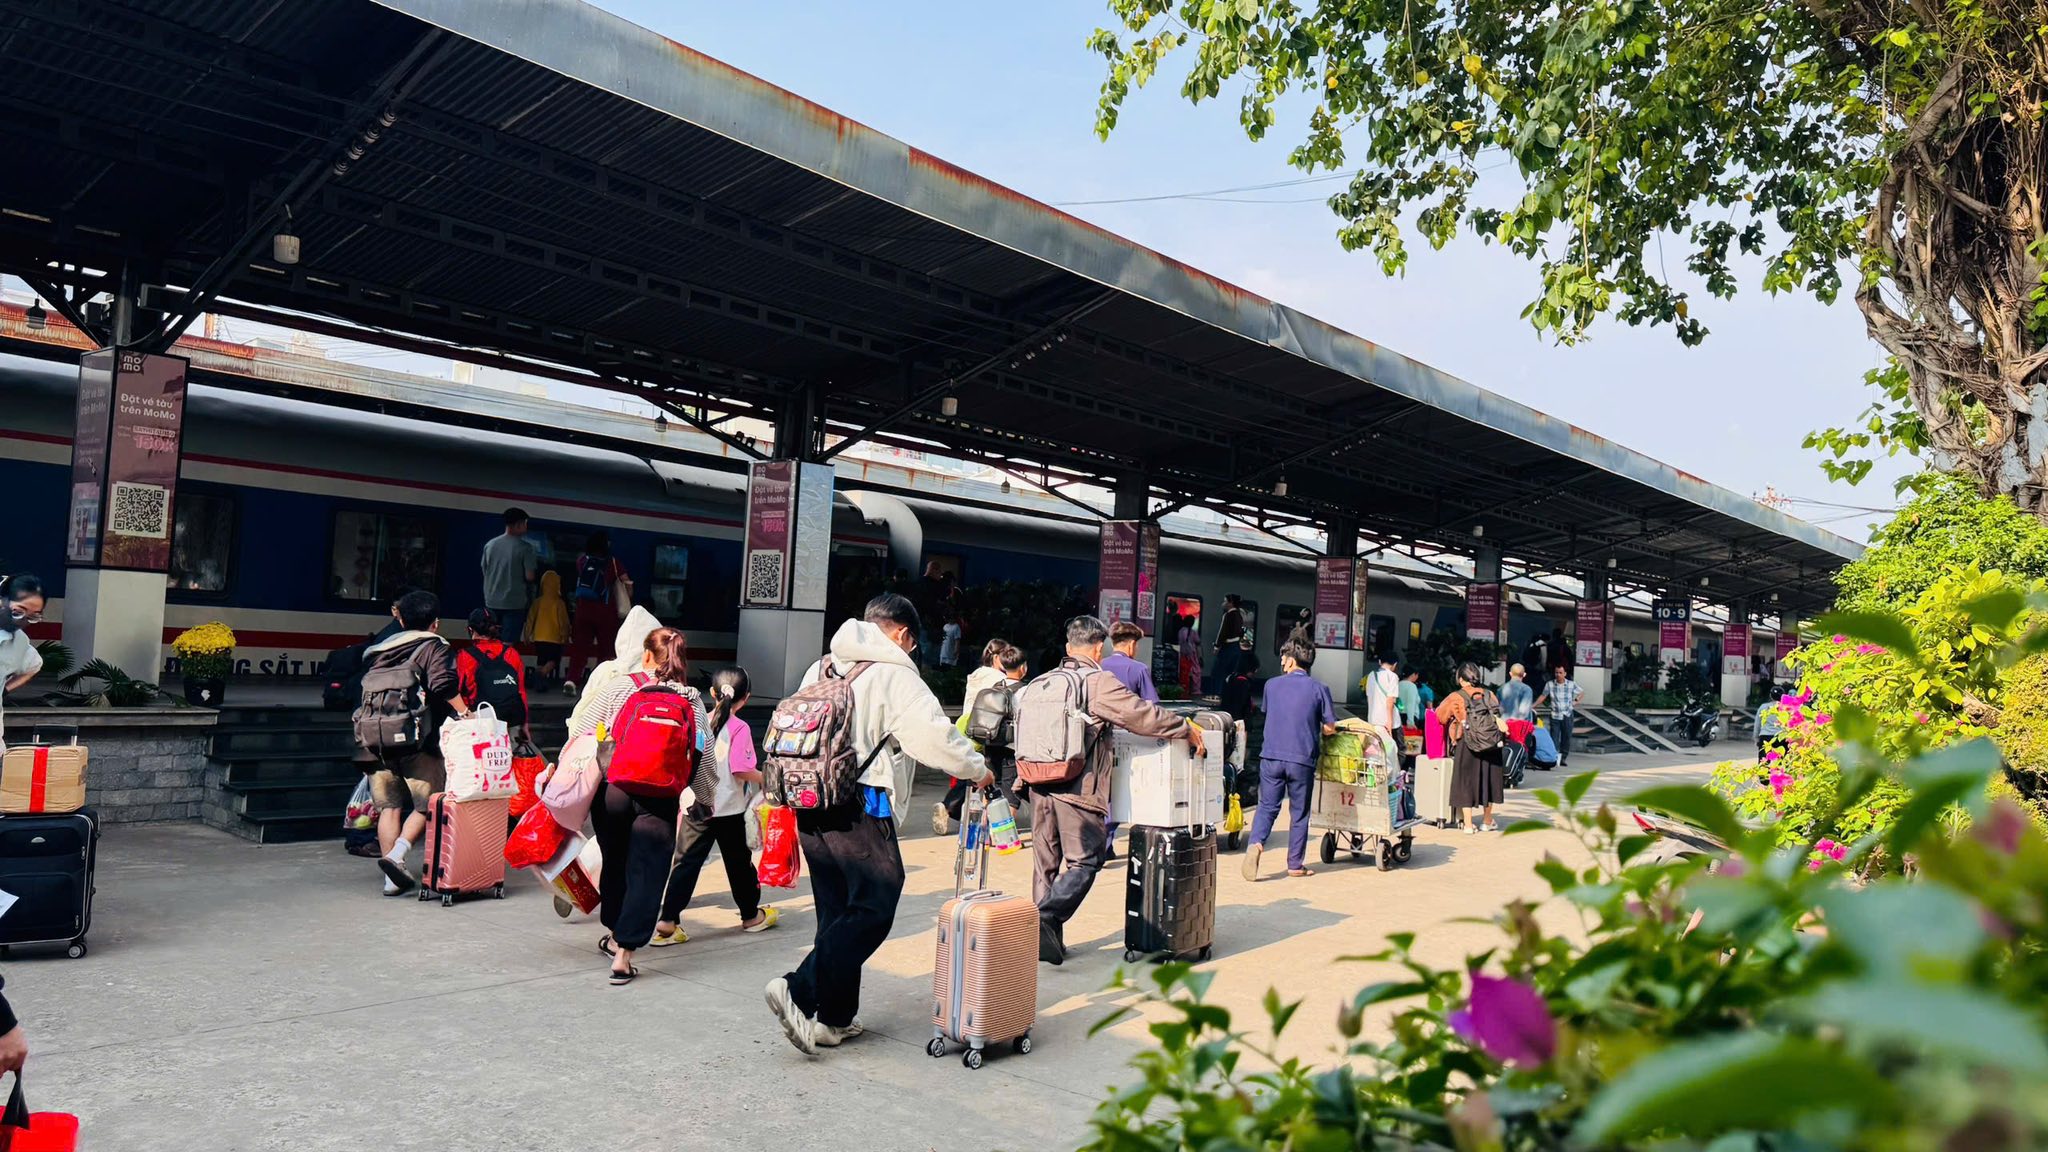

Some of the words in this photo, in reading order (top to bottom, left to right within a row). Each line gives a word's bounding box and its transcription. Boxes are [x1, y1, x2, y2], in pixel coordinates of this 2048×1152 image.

[121, 393, 140, 404] Đặt
[142, 397, 154, 406] vé
[156, 399, 173, 408] tàu
[120, 404, 141, 414] trên
[144, 408, 176, 420] MoMo
[486, 751, 508, 759] DUTY
